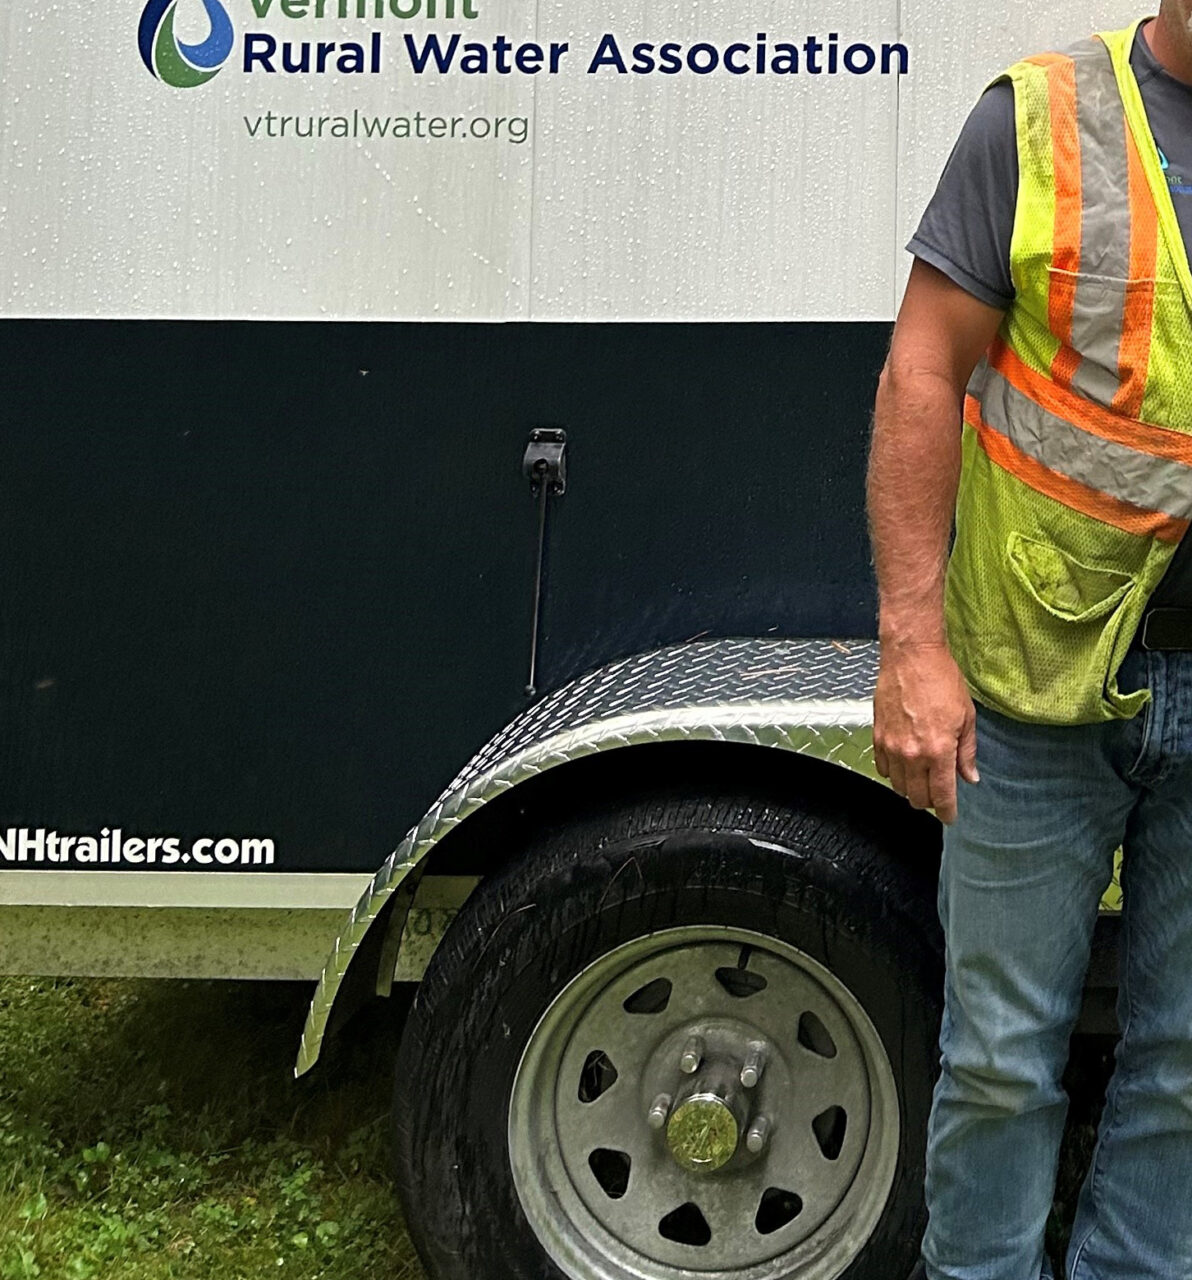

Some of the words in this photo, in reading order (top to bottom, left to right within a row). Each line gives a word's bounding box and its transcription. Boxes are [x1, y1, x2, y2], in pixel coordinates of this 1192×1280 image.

[243, 31, 384, 74] Rural
[403, 33, 569, 75] Water
[587, 33, 910, 75] Association
[244, 109, 530, 144] vtruralwater.org
